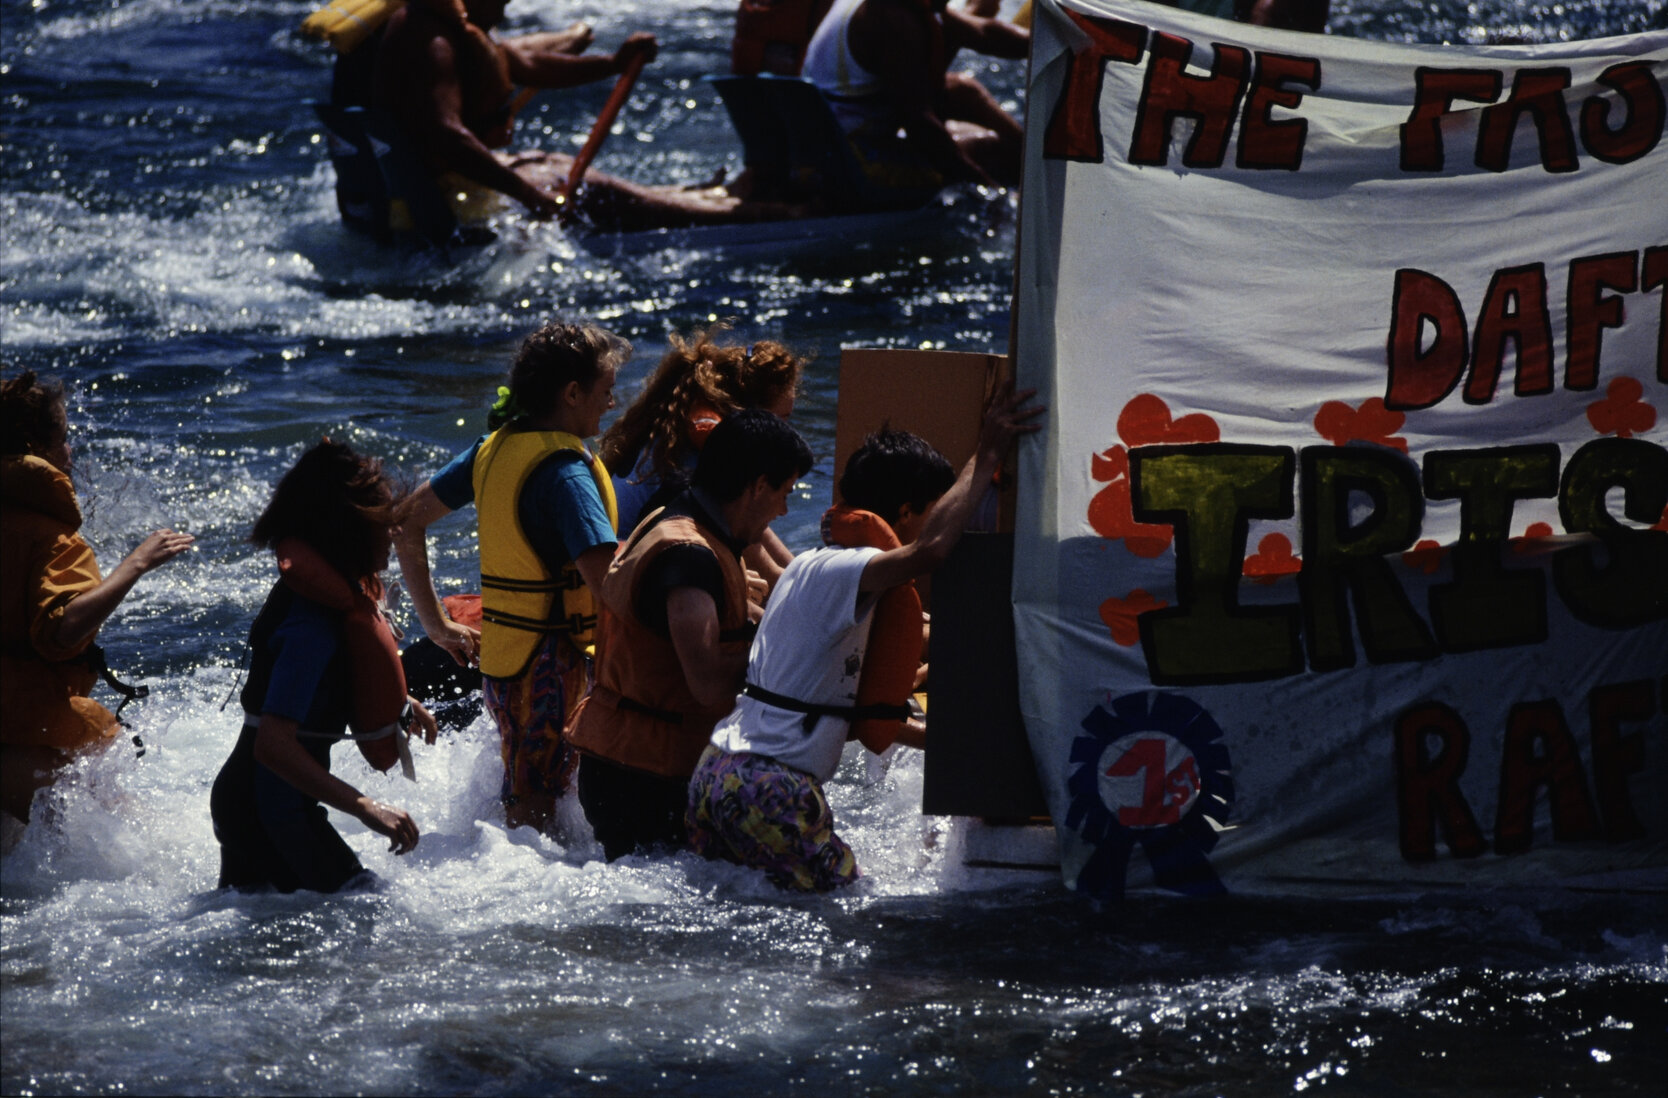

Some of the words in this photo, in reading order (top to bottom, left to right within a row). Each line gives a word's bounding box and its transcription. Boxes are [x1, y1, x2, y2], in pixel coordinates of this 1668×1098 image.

[1043, 6, 1321, 171] THE
[1128, 437, 1668, 686] IRIS
[1393, 675, 1668, 862] RAF
